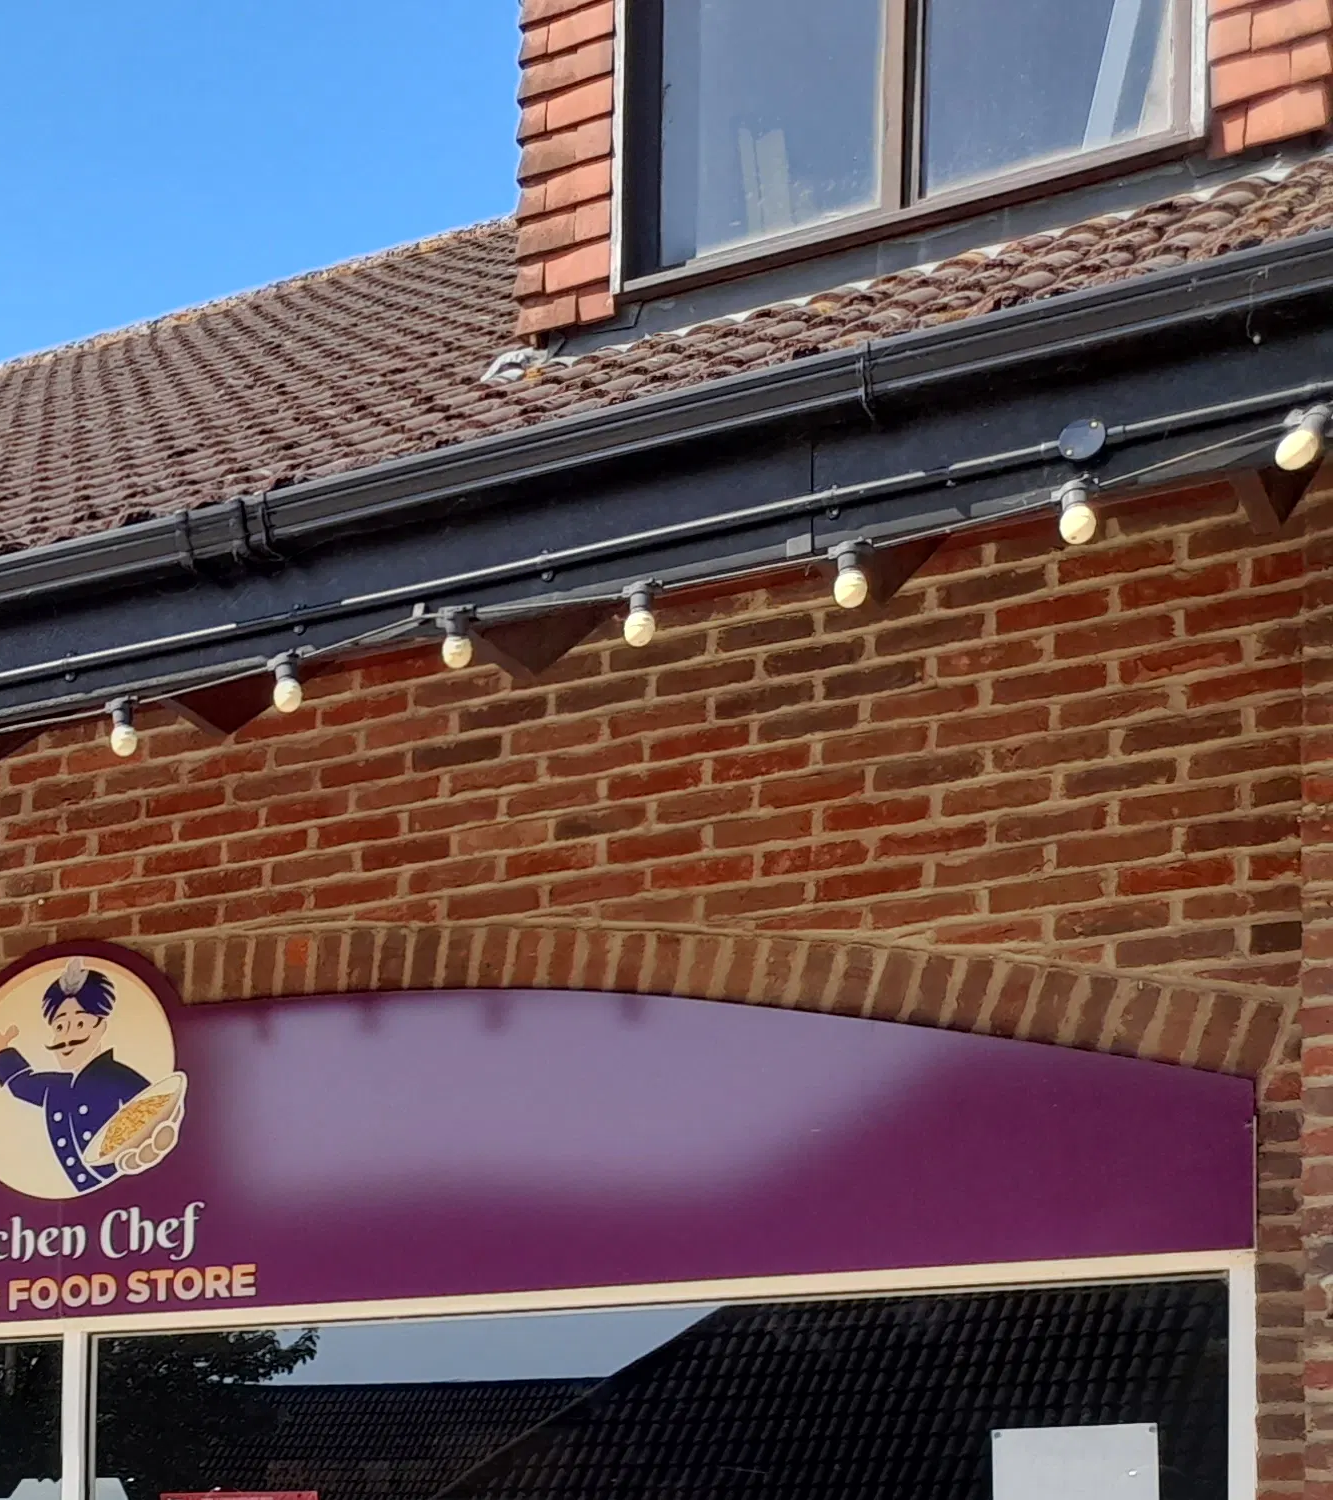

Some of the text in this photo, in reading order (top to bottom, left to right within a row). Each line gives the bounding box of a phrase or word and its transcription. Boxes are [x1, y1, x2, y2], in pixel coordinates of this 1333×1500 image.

[99, 1201, 206, 1261] Chef
[8, 1274, 118, 1312] FOOD
[126, 1263, 258, 1302] STORE
